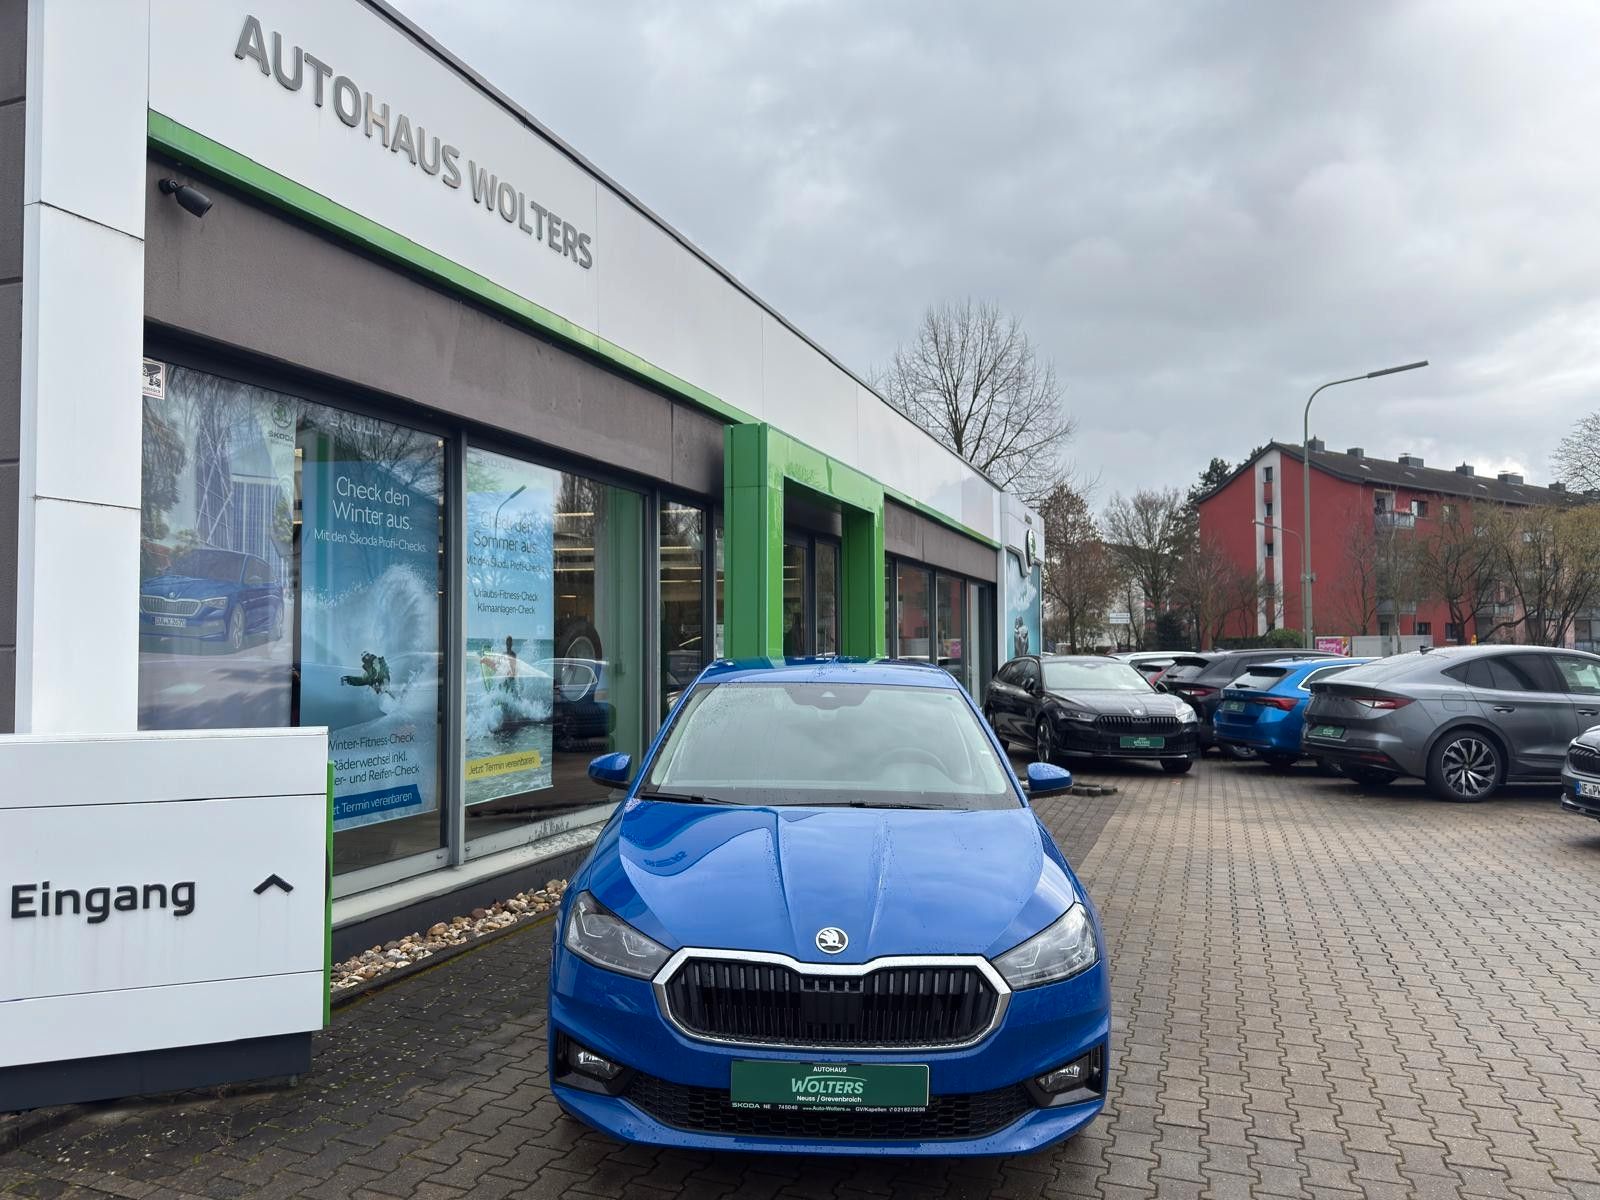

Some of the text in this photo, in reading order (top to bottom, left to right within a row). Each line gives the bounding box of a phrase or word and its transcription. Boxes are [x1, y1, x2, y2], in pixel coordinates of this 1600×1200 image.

[235, 14, 593, 270] AUTOHAUS WOLTERS
[336, 476, 410, 507] Check den
[332, 499, 413, 530] Winter aus.
[314, 528, 331, 541] Mit
[332, 531, 348, 543] den
[473, 531, 519, 552] Sommer
[334, 763, 420, 787] er- und Reifen-Check
[468, 765, 483, 776] Jetzt
[484, 761, 505, 773] Termin
[342, 799, 370, 813] Termin
[371, 791, 413, 807] vereinbaren
[11, 880, 196, 924] Eingang
[791, 1077, 865, 1095] WOLTERS
[796, 1095, 816, 1103] Neuss
[821, 1094, 862, 1103] Grevenbroich
